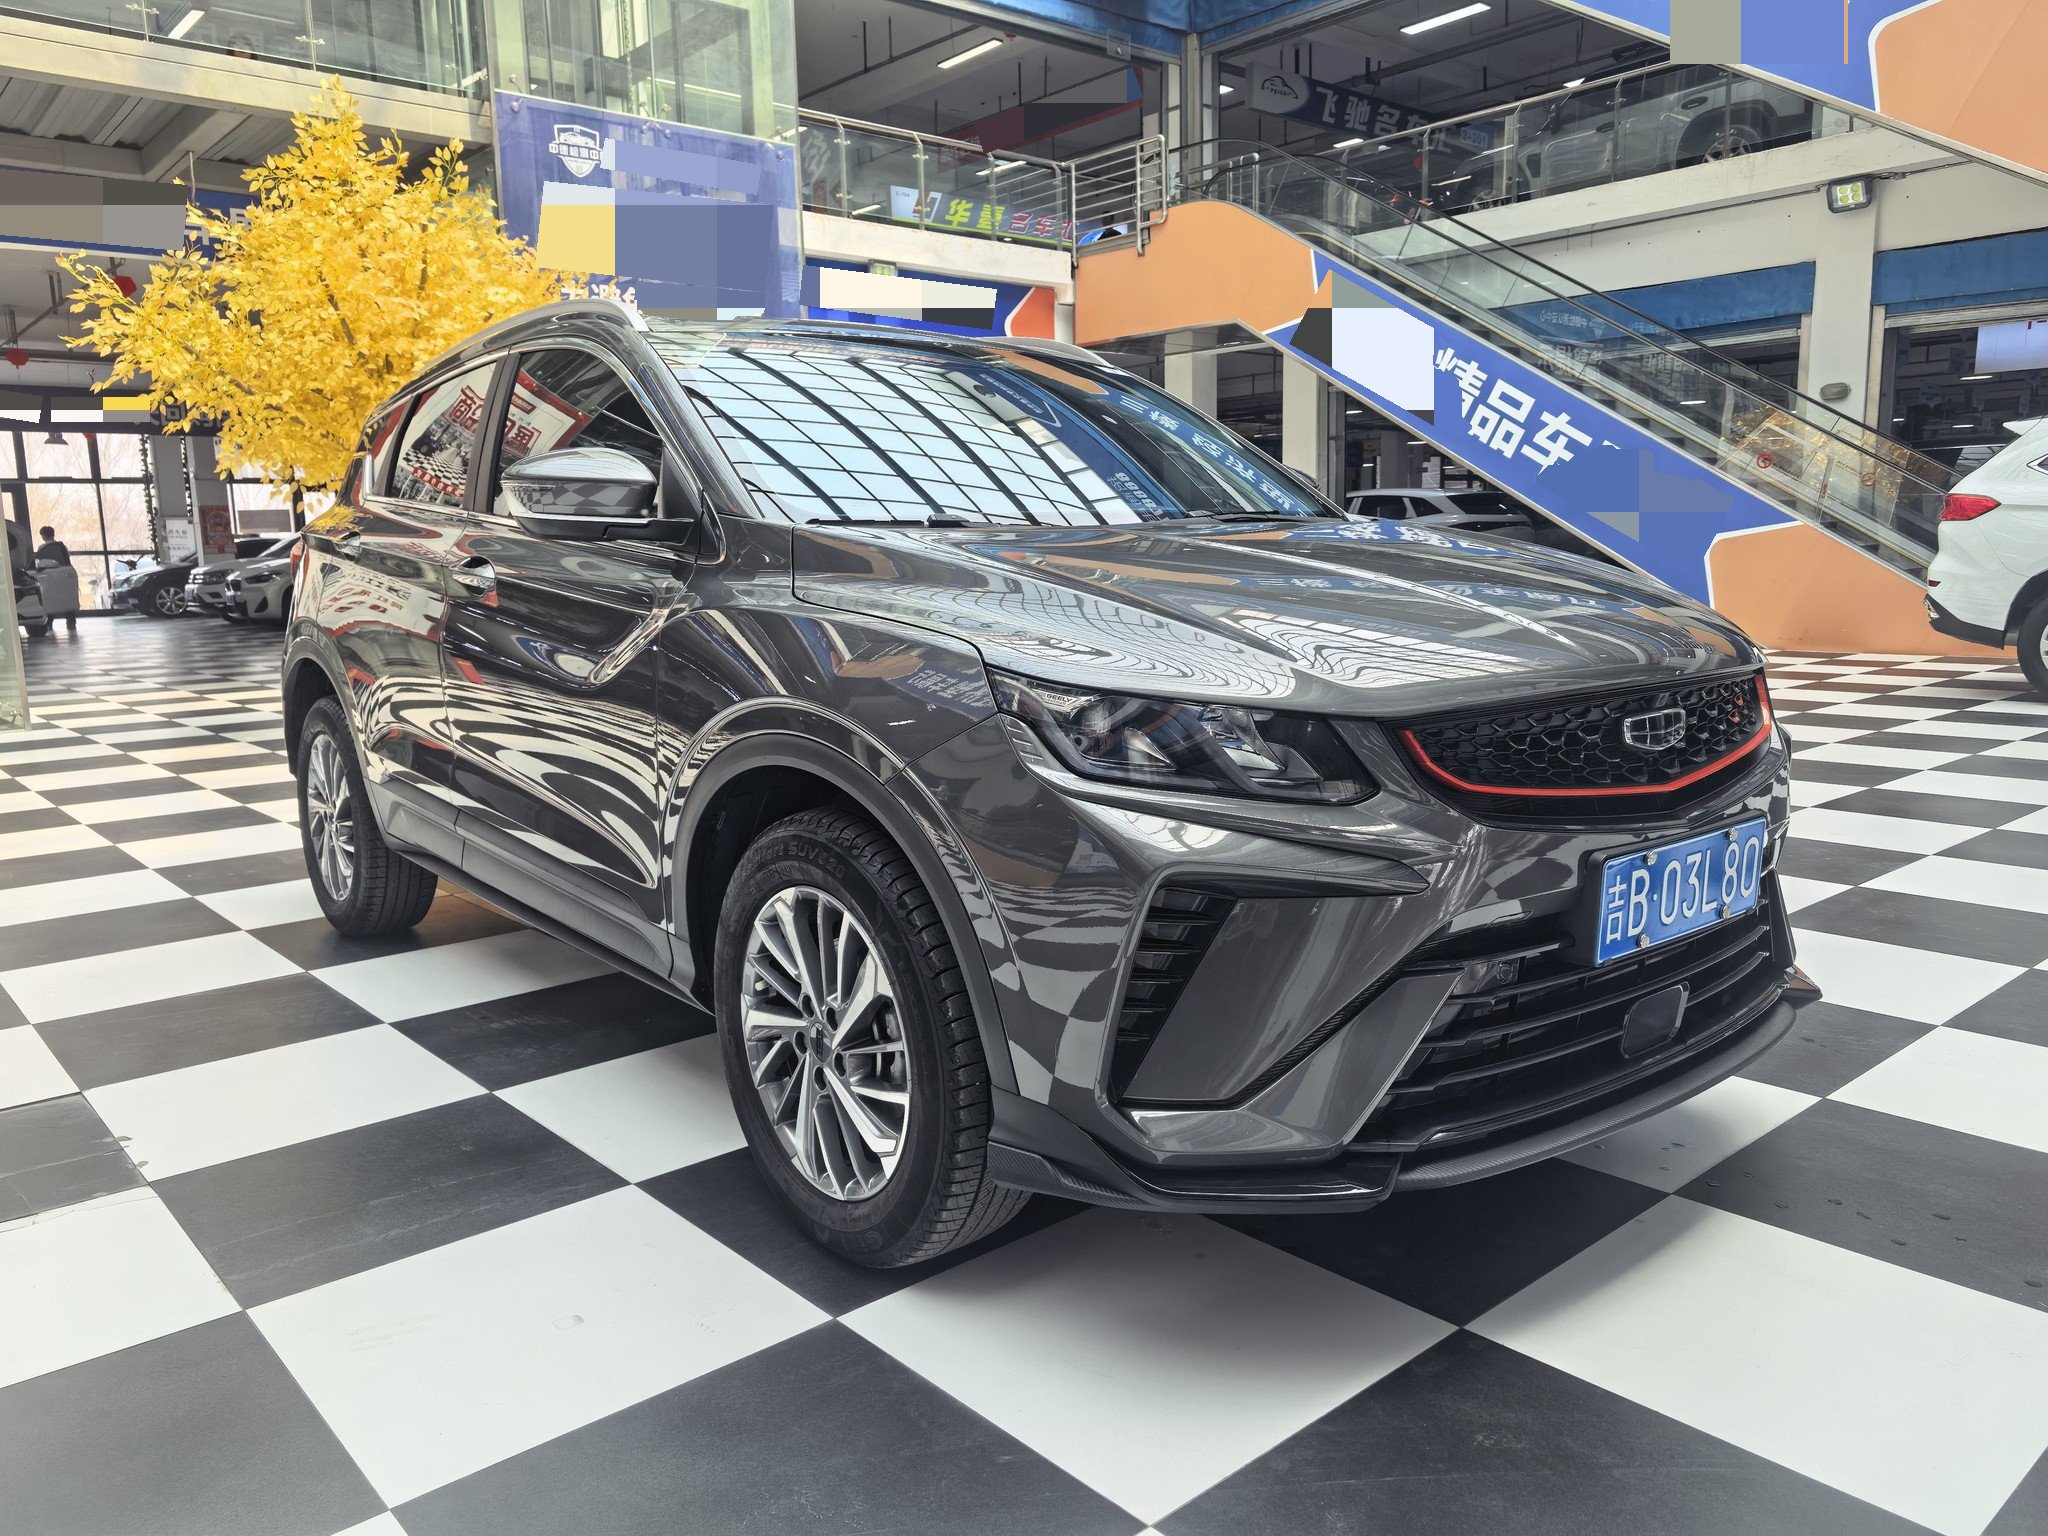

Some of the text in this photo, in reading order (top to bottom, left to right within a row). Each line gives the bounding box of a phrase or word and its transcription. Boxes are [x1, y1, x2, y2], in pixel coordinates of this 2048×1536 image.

[1434, 347, 1622, 476] 精品车
[1046, 693, 1072, 703] GEELY
